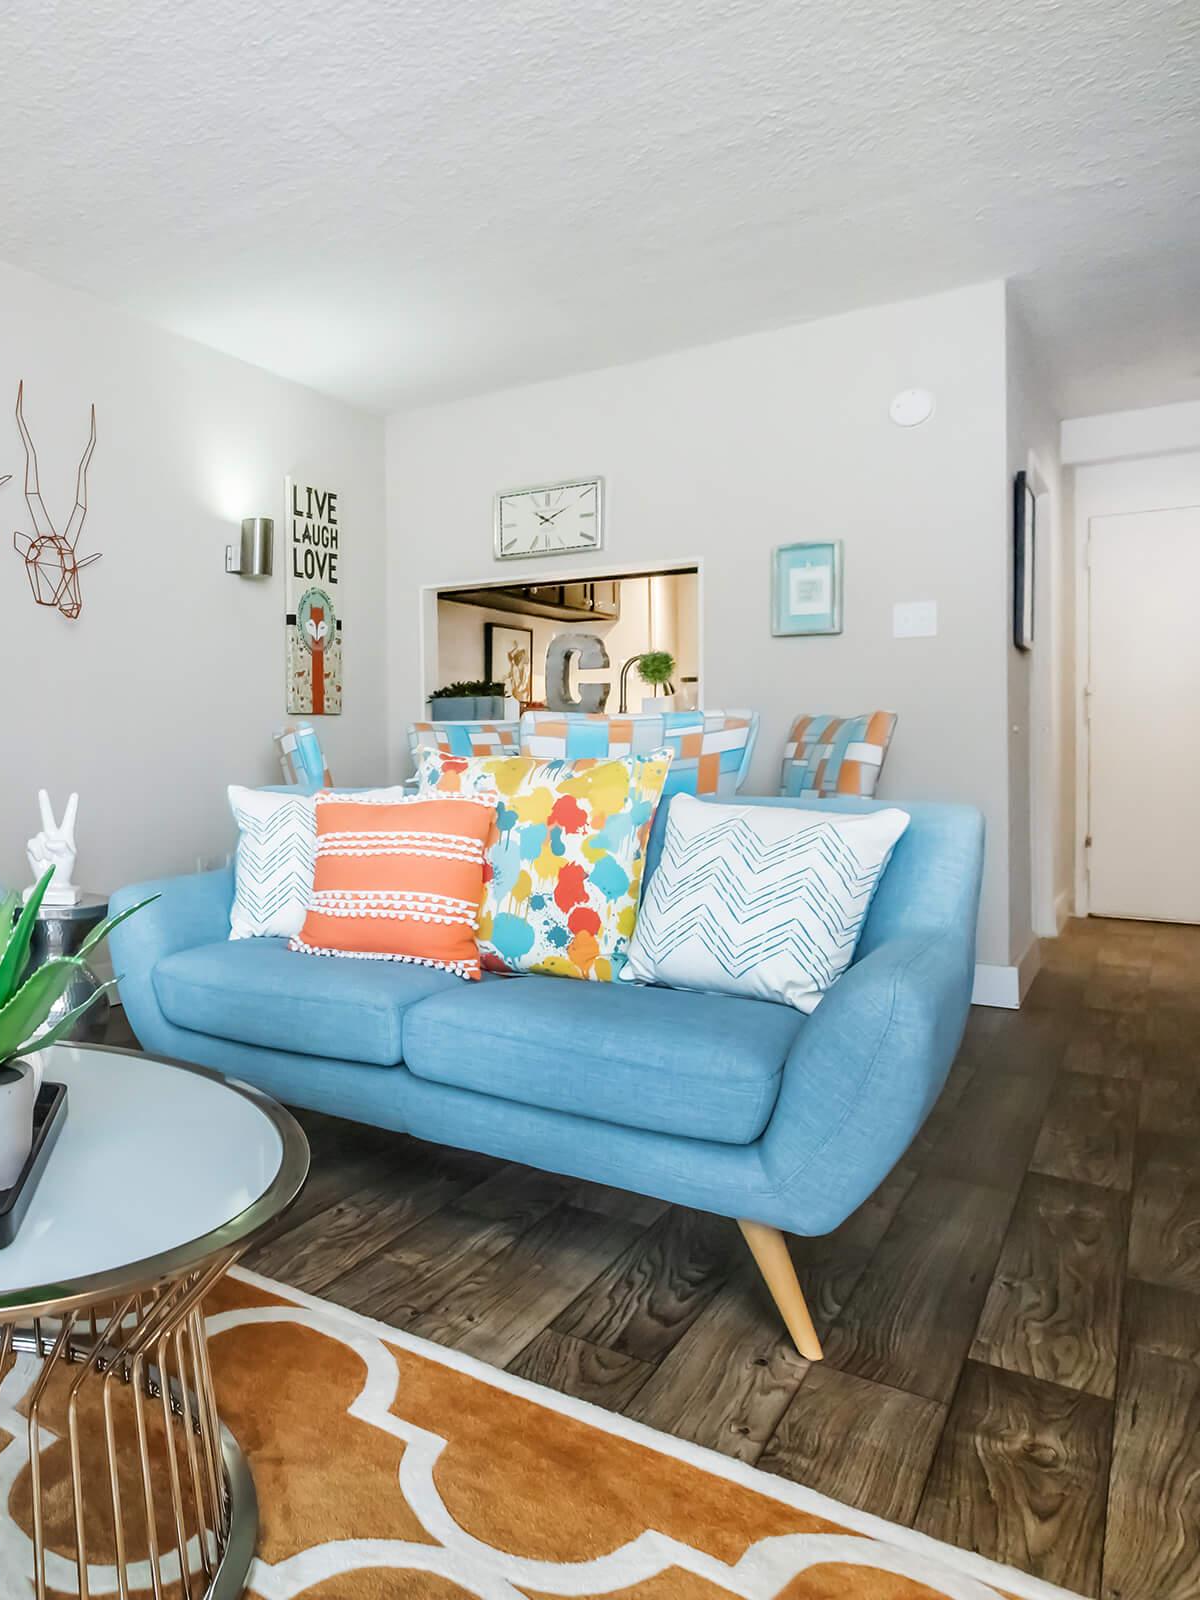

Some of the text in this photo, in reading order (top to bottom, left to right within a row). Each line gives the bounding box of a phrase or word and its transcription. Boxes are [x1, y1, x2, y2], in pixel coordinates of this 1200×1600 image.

[293, 485, 337, 524] LIVE
[293, 520, 338, 549] LAUGH
[293, 547, 338, 584] LOVE
